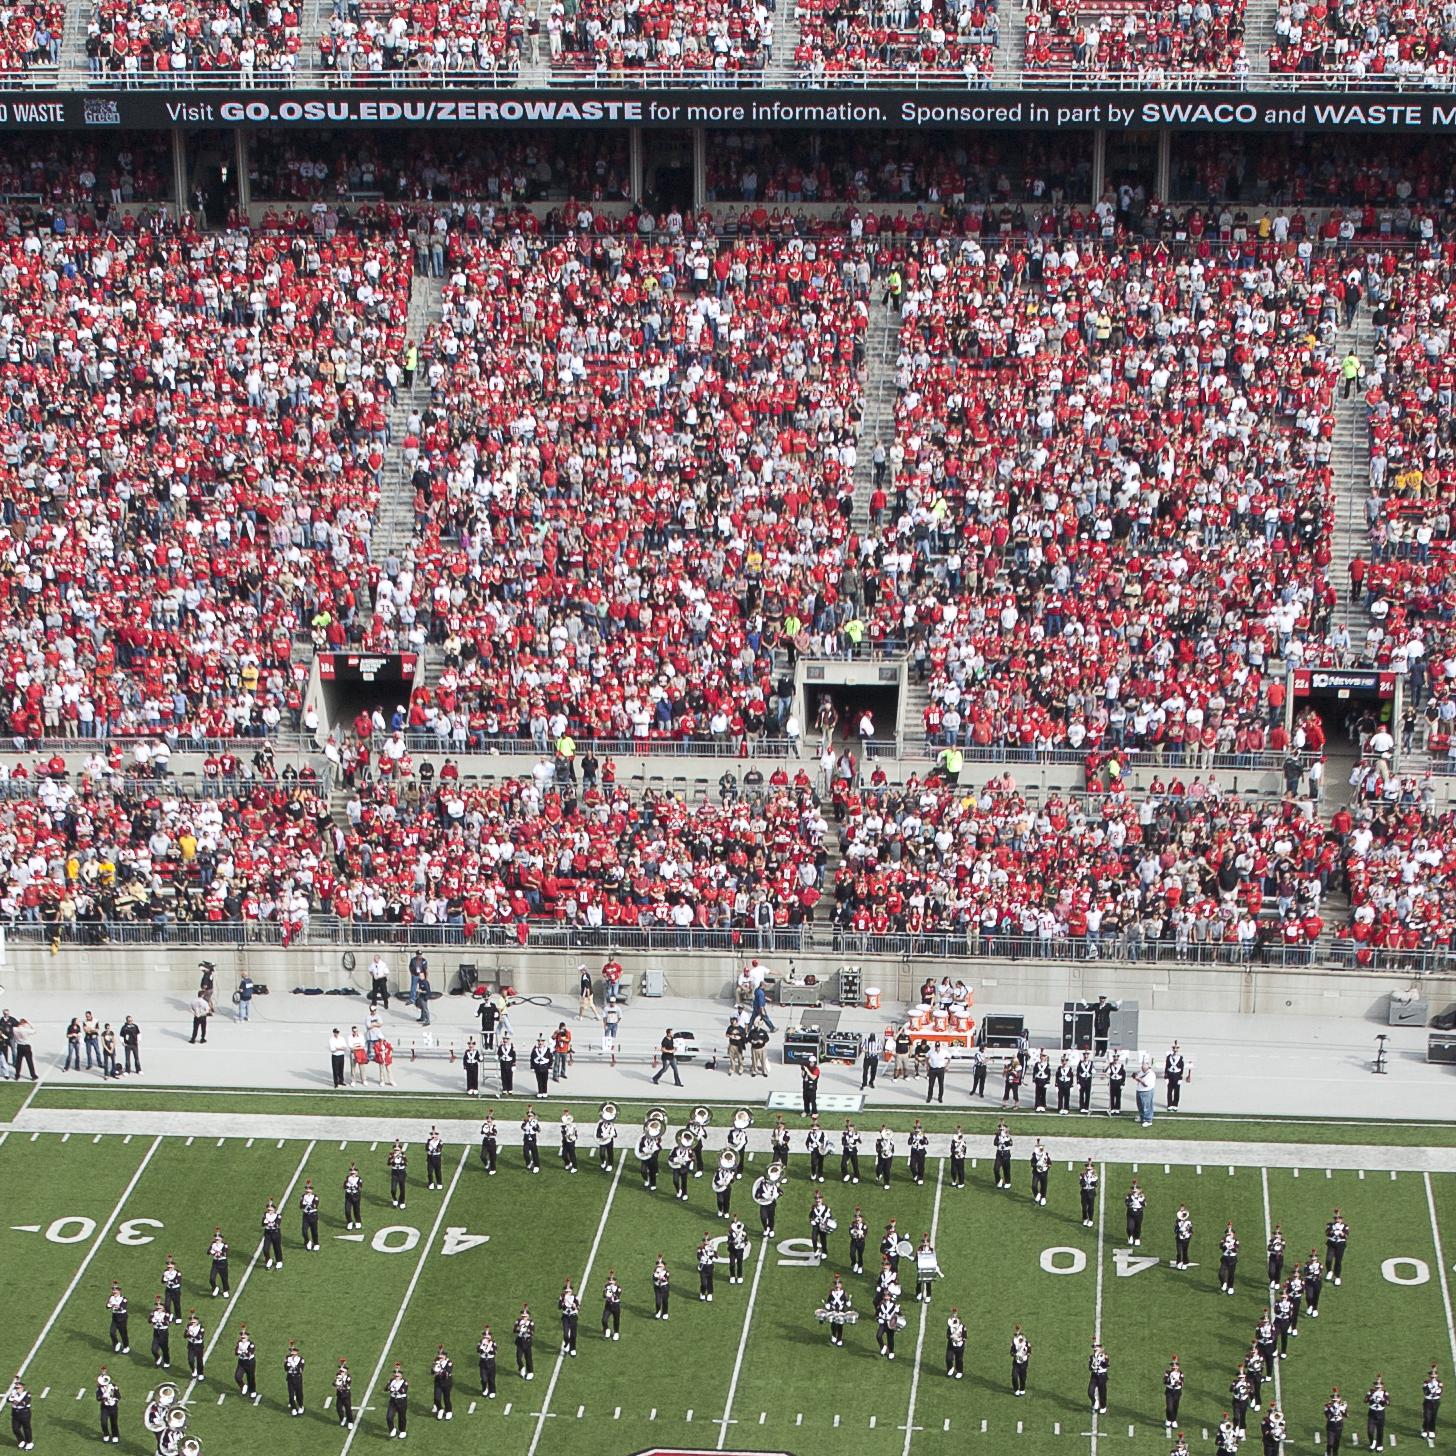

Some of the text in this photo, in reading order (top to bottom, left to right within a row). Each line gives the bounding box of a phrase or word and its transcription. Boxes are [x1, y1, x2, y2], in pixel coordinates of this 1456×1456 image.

[13, 103, 65, 122] WASTE
[165, 102, 214, 121] Visit
[220, 101, 643, 121] GO.OSU.EDU/ZEROWASTE
[648, 101, 681, 120] for
[687, 106, 745, 120] more
[752, 101, 887, 121] information.
[901, 102, 1022, 125] Sponsored
[1030, 102, 1049, 122] in
[1057, 104, 1101, 126] part
[1108, 103, 1135, 126] by
[1141, 103, 1257, 123] SWACO
[1264, 104, 1306, 124] and
[1313, 104, 1422, 125] WASTE
[44, 1215, 165, 1246] 30
[371, 1226, 491, 1255] 40
[1039, 1246, 1160, 1279] 40
